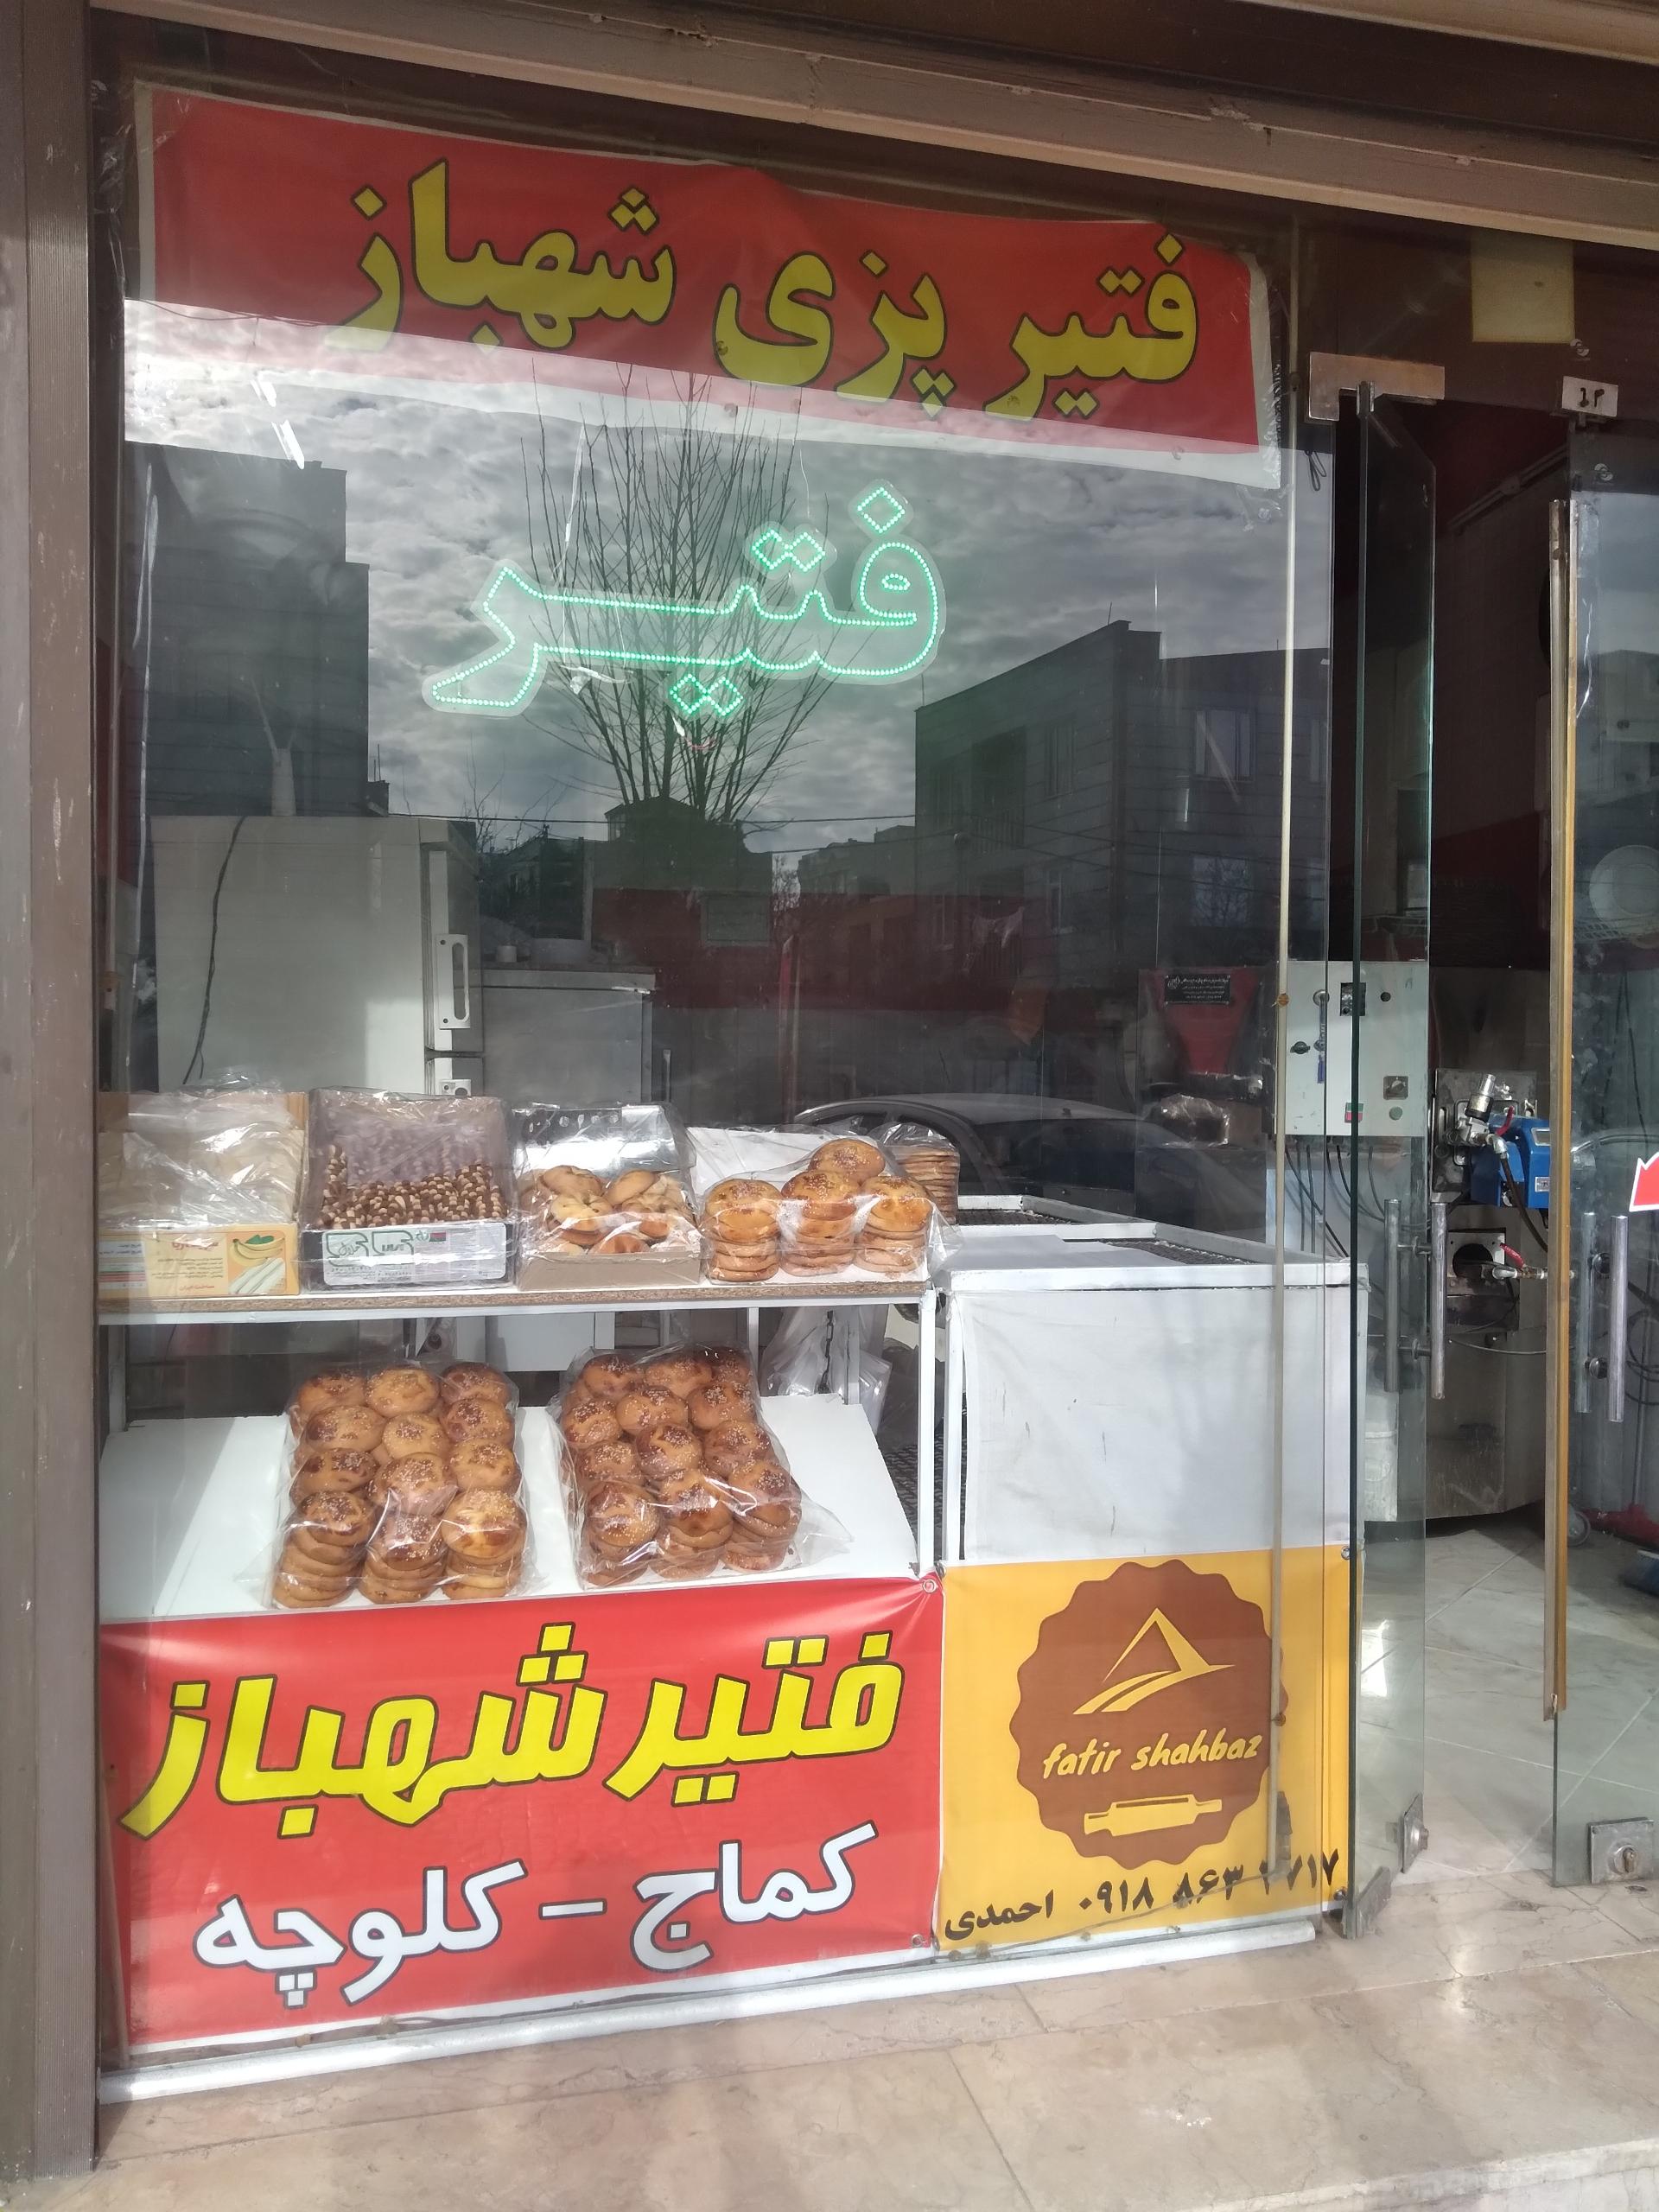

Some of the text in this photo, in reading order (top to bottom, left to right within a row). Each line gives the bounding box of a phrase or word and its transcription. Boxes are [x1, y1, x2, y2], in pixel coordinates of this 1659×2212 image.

[324, 156, 1199, 421] فتیر پزی شهباز
[431, 486, 938, 716] فتیر
[118, 1621, 906, 1840] فتیر شهباز
[1042, 1727, 1263, 1780] fatir shahbaz
[192, 1859, 526, 2010] کلوچه
[630, 1821, 877, 1974] کماج
[944, 1889, 1055, 1941] احمدی
